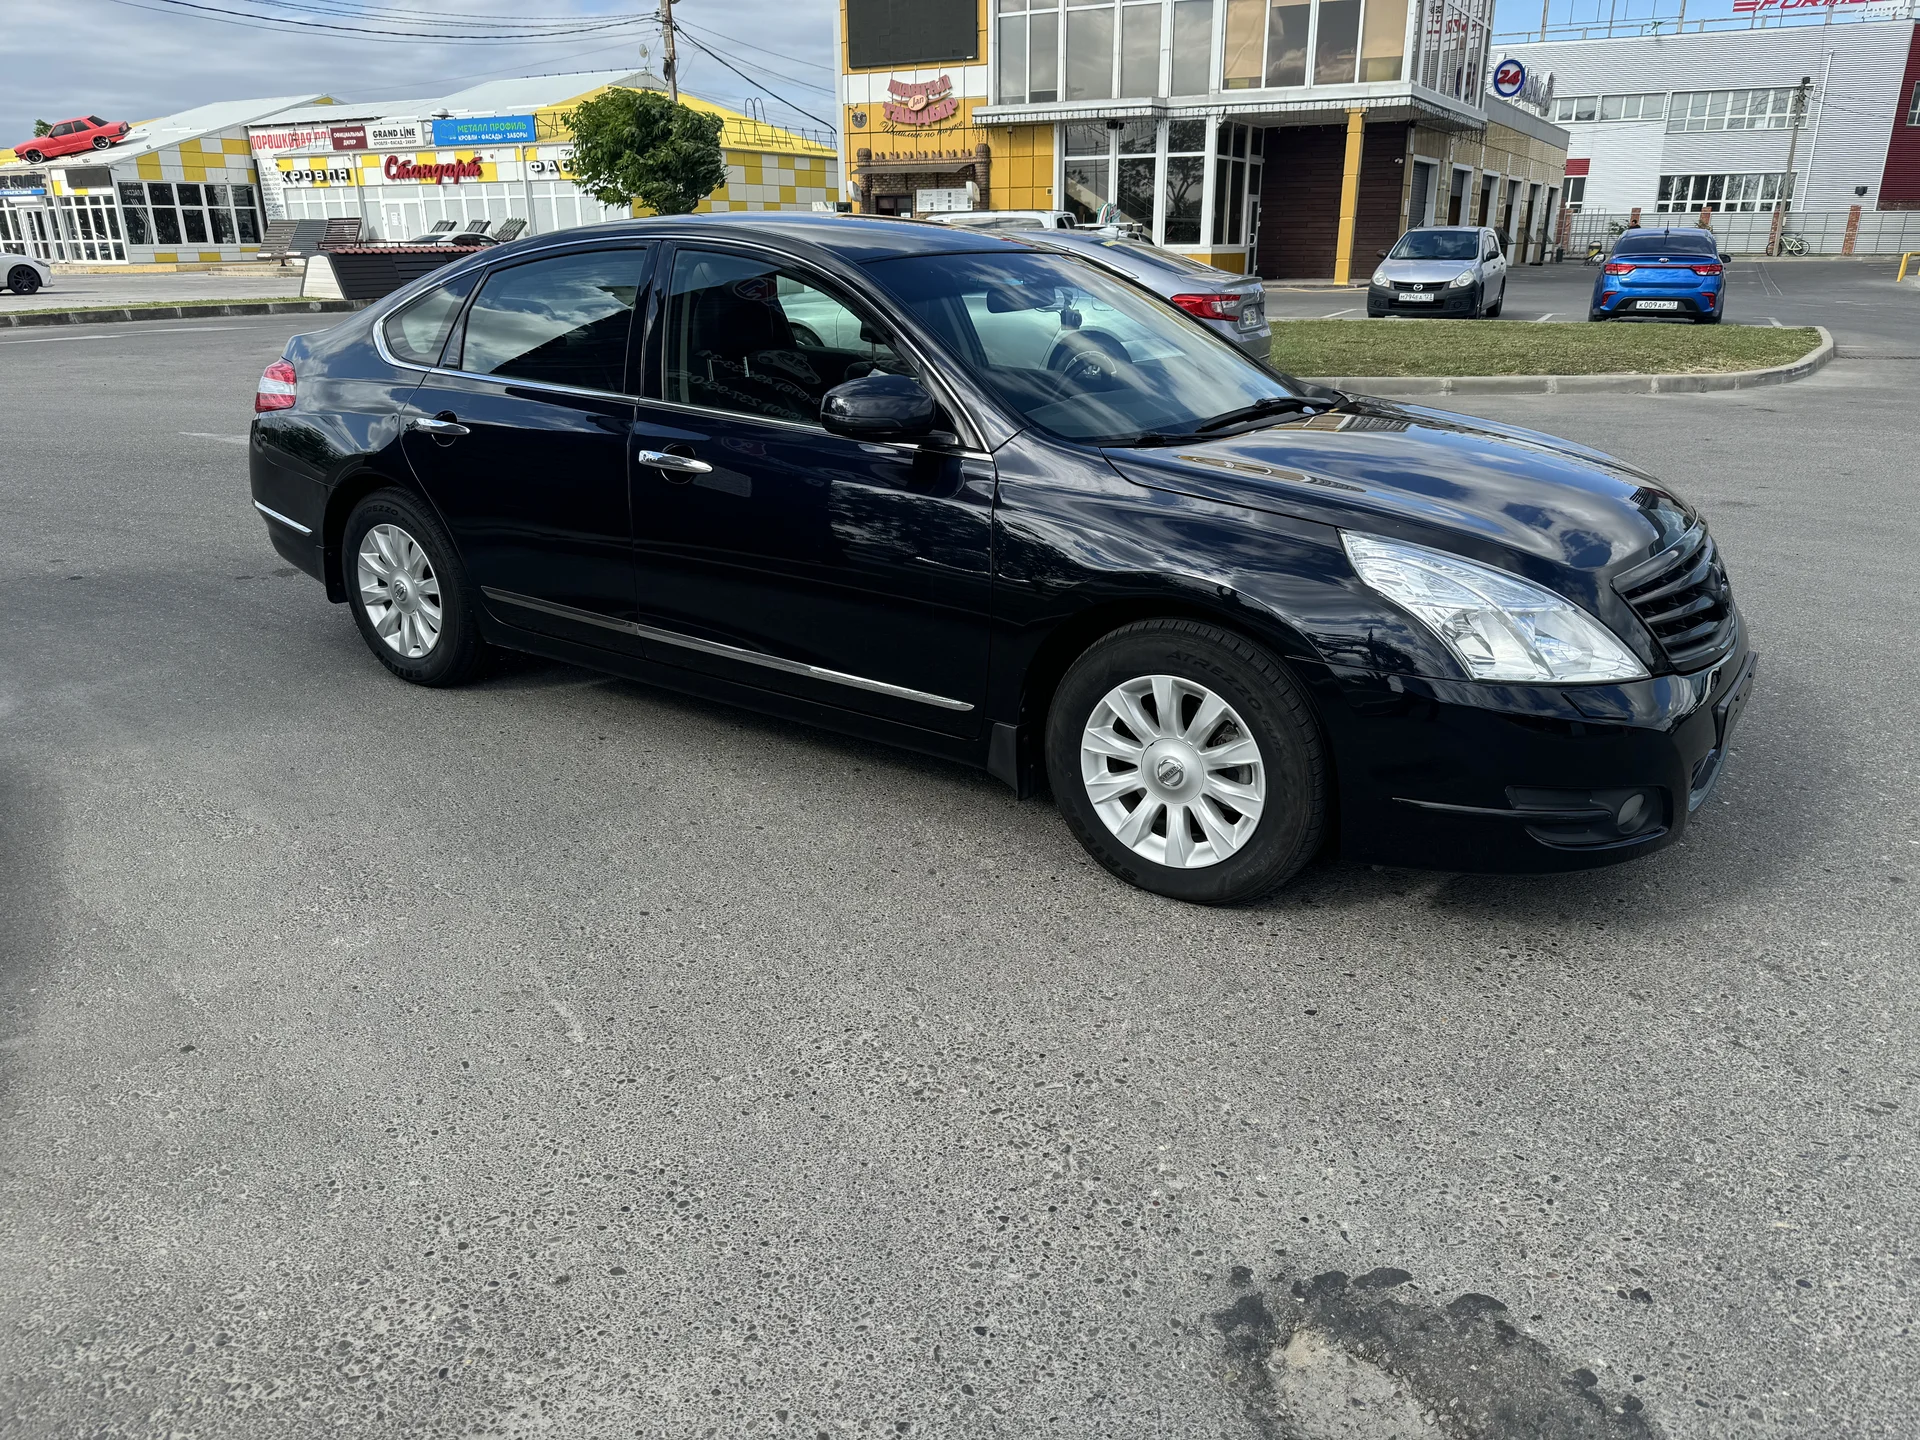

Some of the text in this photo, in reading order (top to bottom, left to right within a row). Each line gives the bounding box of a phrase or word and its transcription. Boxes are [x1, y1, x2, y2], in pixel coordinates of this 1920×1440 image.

[887, 74, 953, 98] МАНГАЛ
[1497, 69, 1521, 86] 24
[883, 97, 958, 127] ТАНДЫР
[372, 128, 398, 139] GRAND
[457, 121, 527, 133] МЕТАЛЛ ПРОФИЛЬ
[507, 131, 528, 139] ЗАБОРЫ
[924, 130, 935, 138] по
[250, 131, 312, 150] ПОРОШКОВАЯ
[281, 168, 349, 183] КРОВЛЯ
[384, 154, 483, 185] Стандарт
[1166, 650, 1283, 754] ATREZZO ELITE
